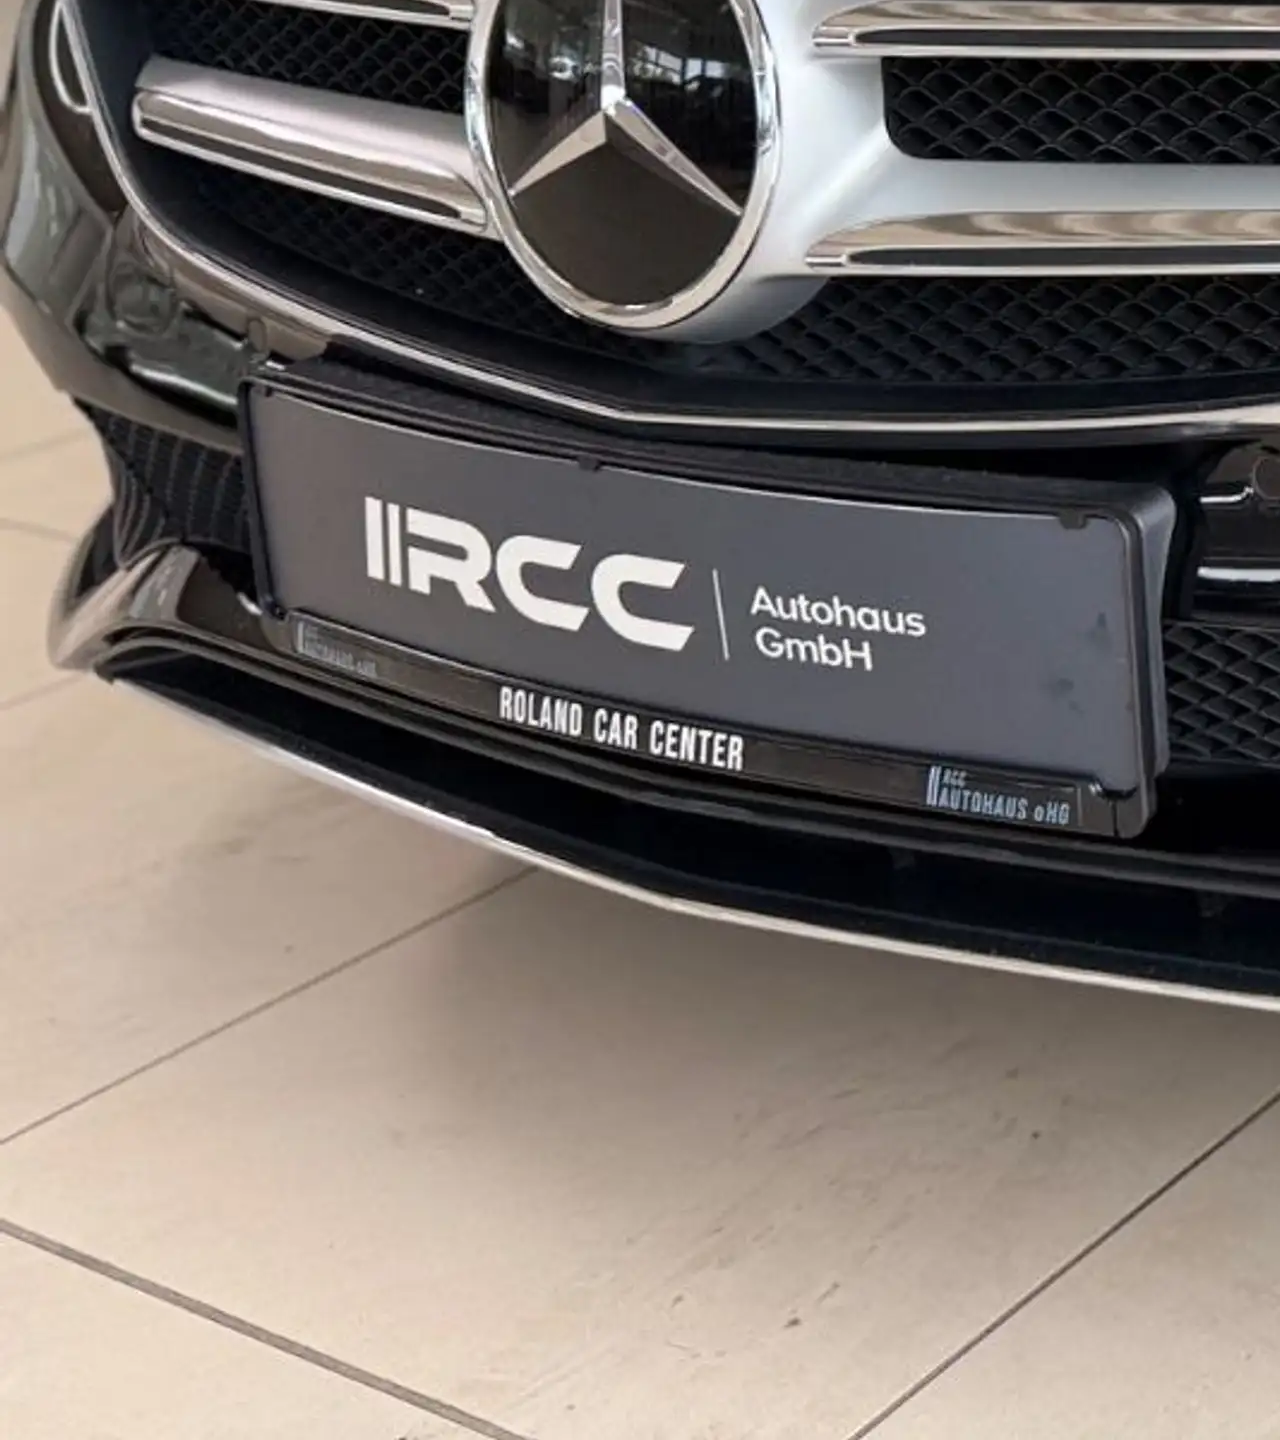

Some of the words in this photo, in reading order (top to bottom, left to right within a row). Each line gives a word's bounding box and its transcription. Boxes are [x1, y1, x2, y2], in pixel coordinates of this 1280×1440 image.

[750, 585, 927, 637] Autohaus
[755, 626, 874, 672] GmbH
[500, 686, 583, 738] ROLAND
[593, 708, 638, 750] CAR
[649, 720, 744, 772] CENTER
[938, 787, 1028, 820] AUTOHAUS
